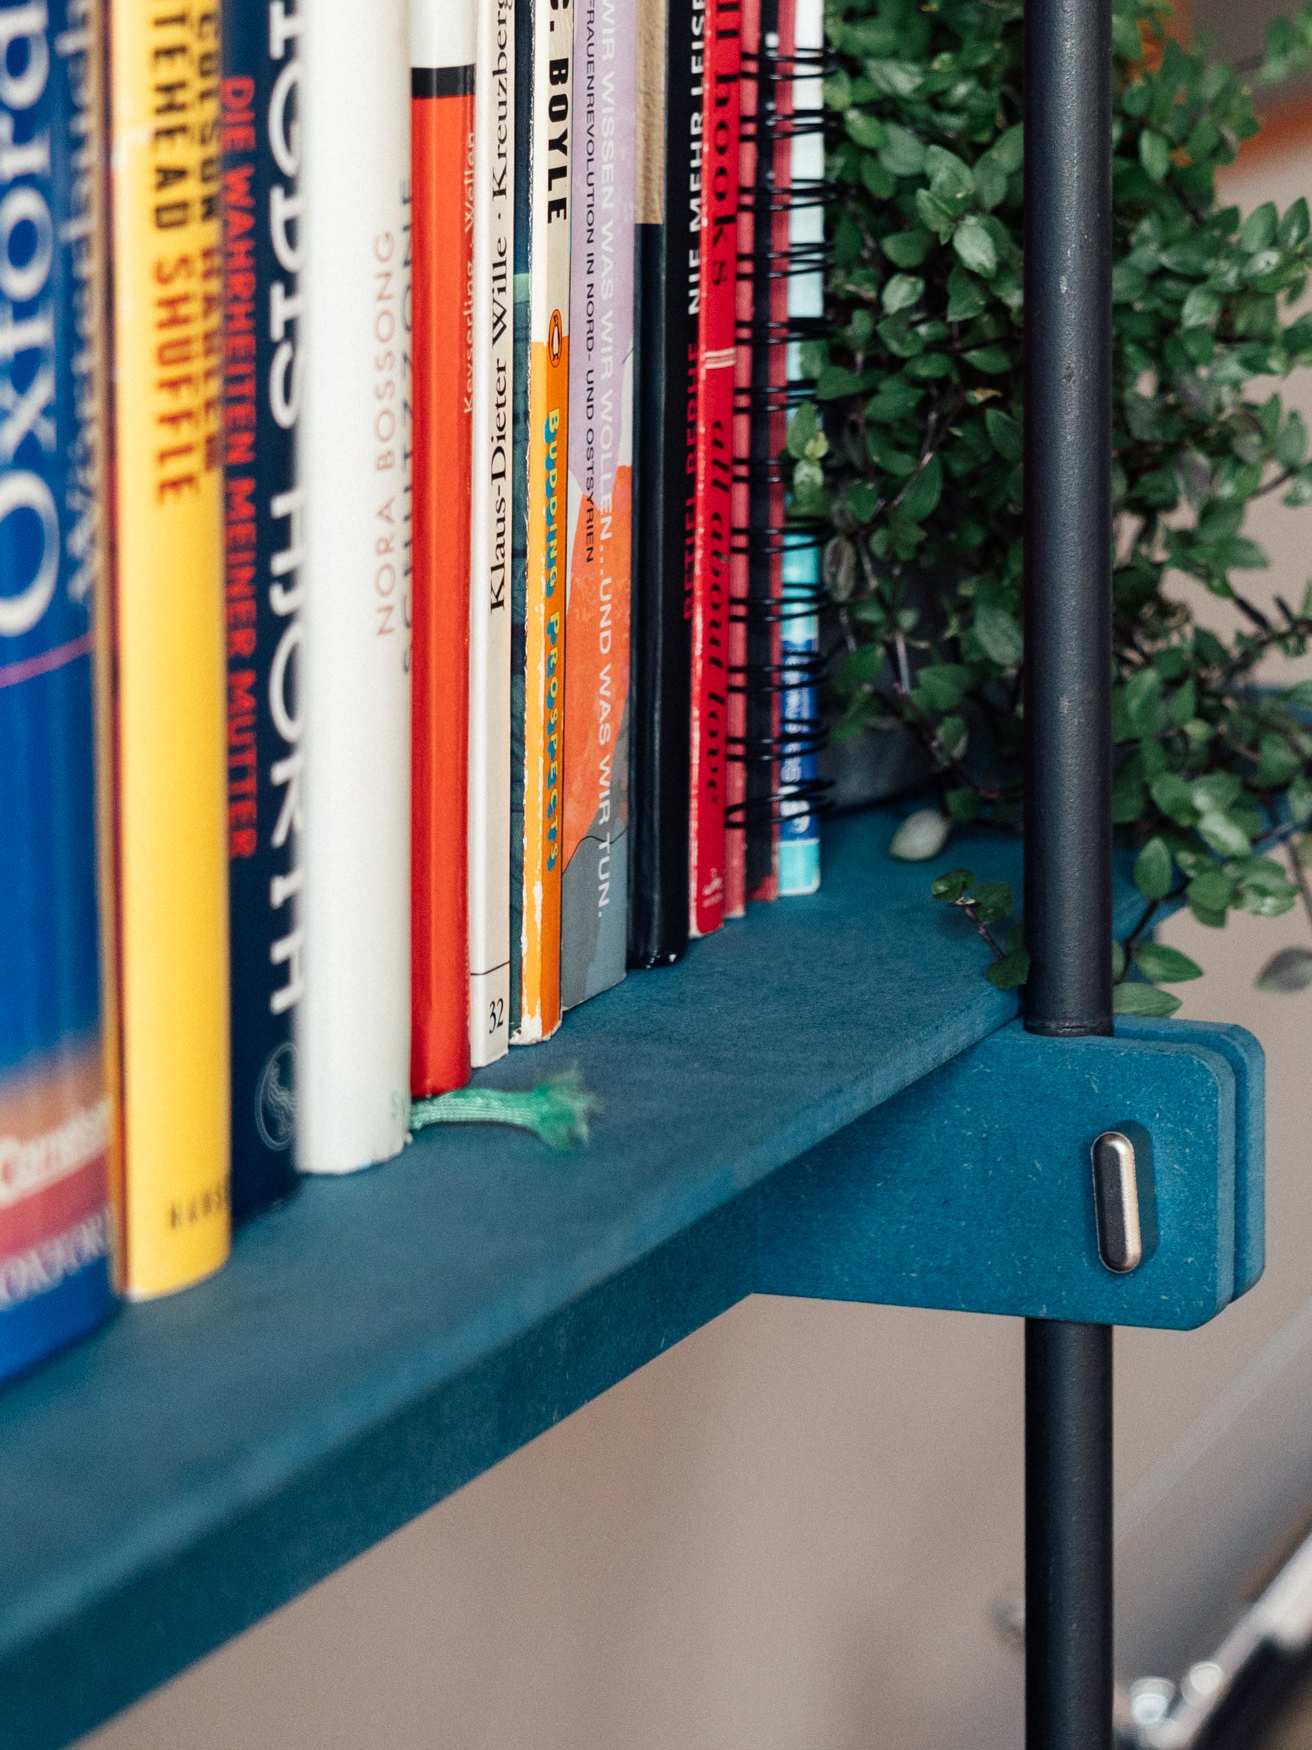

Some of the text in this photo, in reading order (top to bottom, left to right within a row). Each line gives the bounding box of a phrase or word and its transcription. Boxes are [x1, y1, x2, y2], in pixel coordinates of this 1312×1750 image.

[547, 57, 571, 225] BOYLE
[600, 70, 615, 209] WISSEN
[710, 73, 739, 288] hooks
[491, 236, 508, 348] Wille
[585, 250, 595, 276] IN
[585, 283, 596, 362] NORD-
[599, 219, 614, 302] WAS
[155, 255, 198, 506] SHUFFLE
[585, 369, 595, 426] UND
[599, 311, 614, 381] WIR
[220, 74, 258, 861] DIE WAHRHEITEN MEINER MUTTER
[373, 231, 396, 637] NORA BOSSONG
[489, 357, 508, 615] Klaus-Dieter
[585, 428, 595, 564] OSTSYRIEN
[545, 407, 562, 869] BUDDING PROSPECTS
[706, 419, 731, 804] all about love
[598, 663, 613, 746] WAS
[598, 753, 612, 826] WIR
[597, 832, 611, 919] TUN.
[488, 997, 505, 1035] 32
